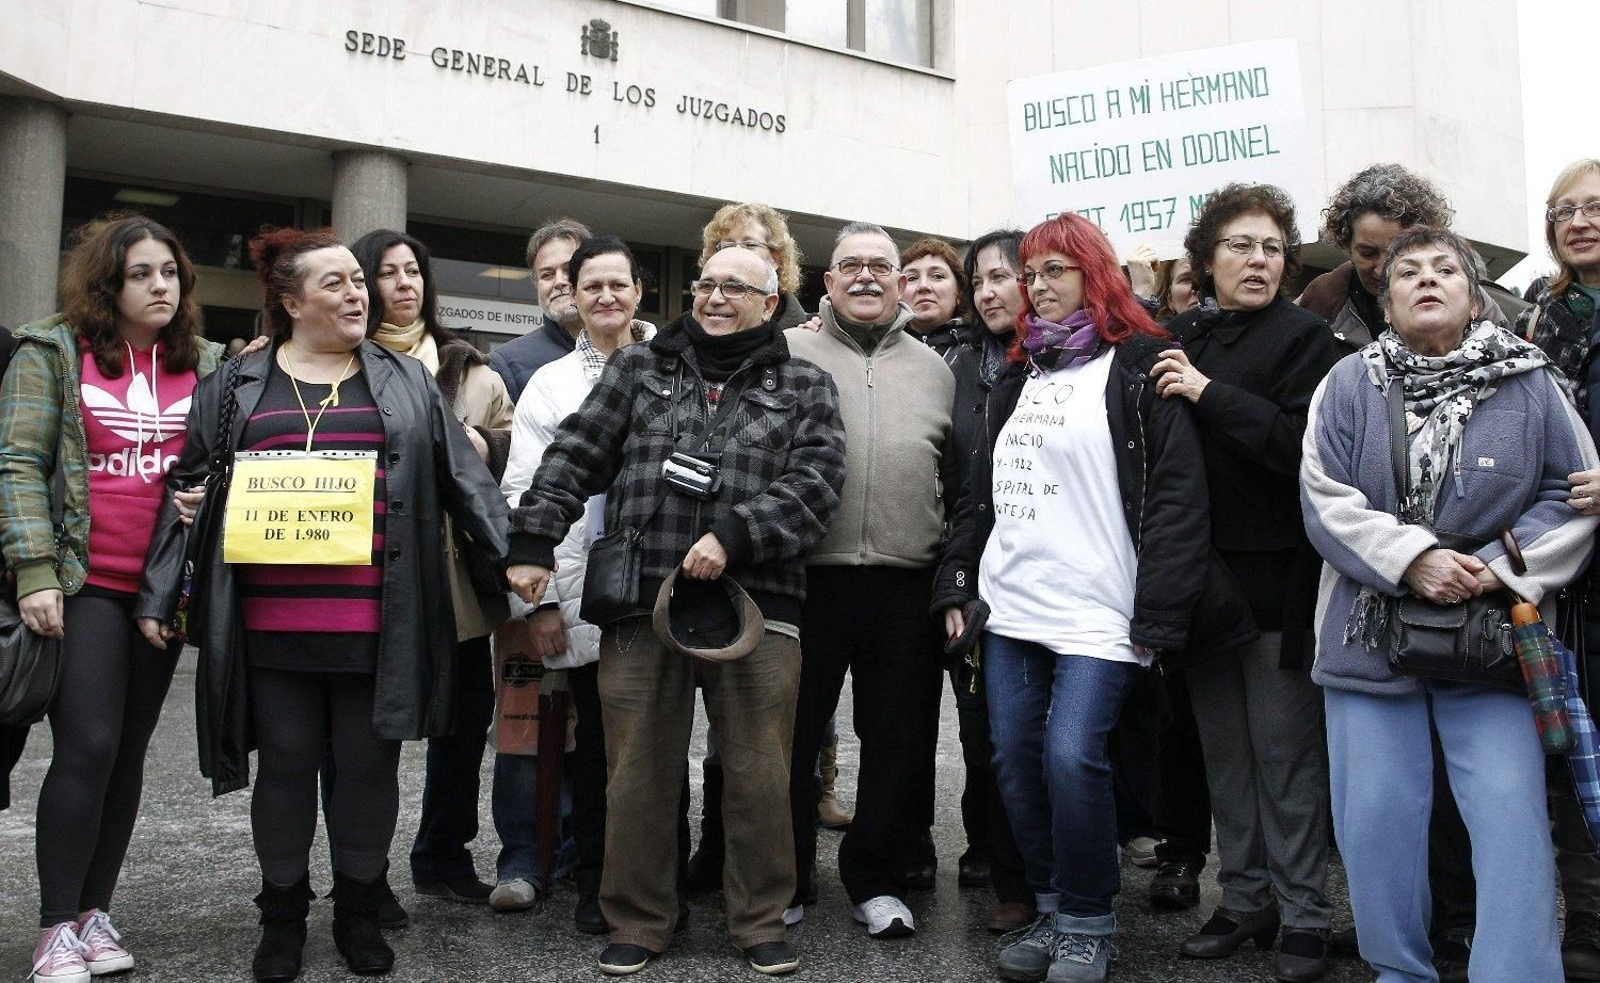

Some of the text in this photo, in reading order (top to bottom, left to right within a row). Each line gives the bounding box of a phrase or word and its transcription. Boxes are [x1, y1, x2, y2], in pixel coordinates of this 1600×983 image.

[344, 30, 786, 133] SEDE GENERAL DE LOS JUZGADOS
[1023, 93, 1096, 132] BUSCO
[1106, 89, 1122, 119] A
[1160, 66, 1269, 112] HERMANO
[593, 125, 600, 144] 1
[1142, 138, 1173, 172] EN
[1182, 124, 1280, 167] ODONEL
[1119, 197, 1177, 233] 1957
[435, 306, 484, 320] ZGADOS
[487, 312, 502, 322] DE
[1017, 382, 1074, 408] SCO
[86, 447, 180, 477] adid
[247, 476, 357, 490] BUSCO HIJO
[993, 480, 1059, 495] SPITAL DE
[245, 510, 354, 522] 11 DE ENERO
[995, 503, 1036, 521] NTESA
[264, 528, 330, 541] DE 1.980
